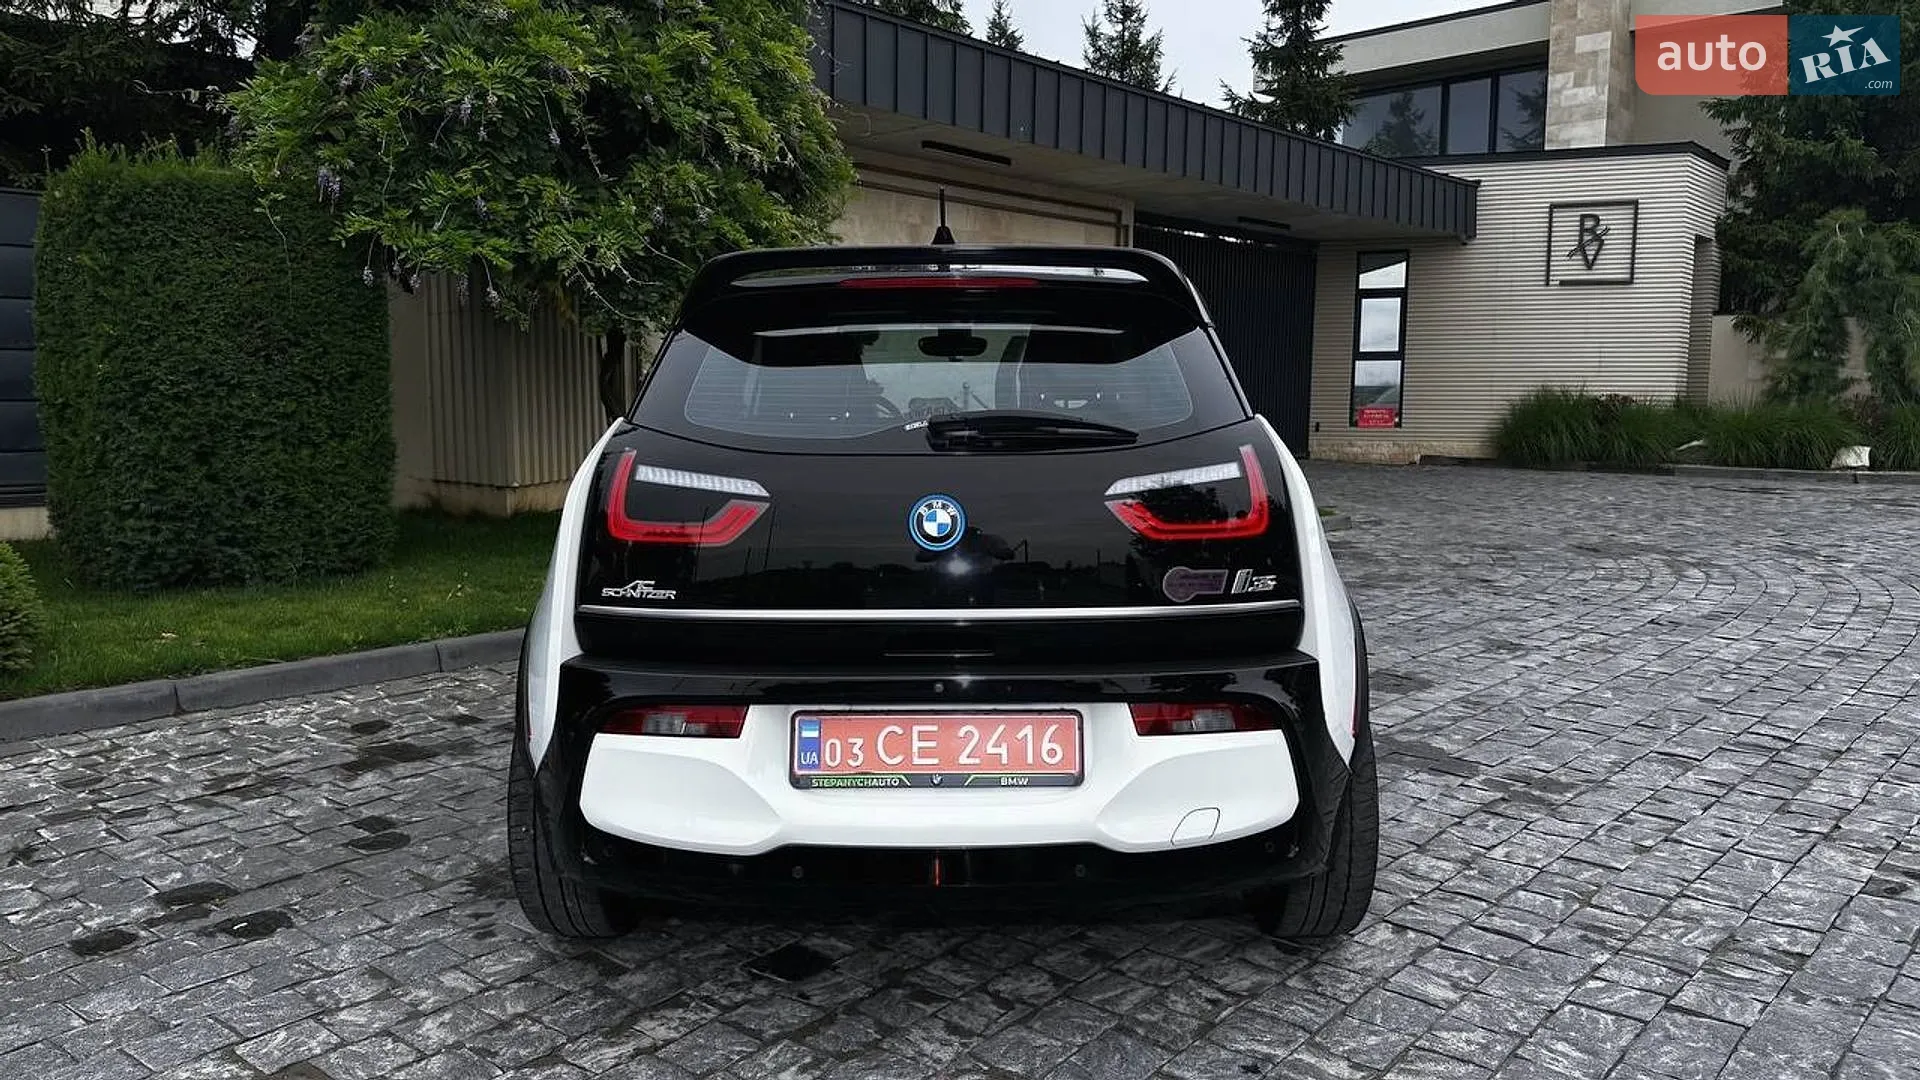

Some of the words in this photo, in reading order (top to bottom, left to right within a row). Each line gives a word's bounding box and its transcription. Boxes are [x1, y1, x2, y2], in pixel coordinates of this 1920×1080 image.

[918, 500, 958, 516] BMW
[800, 752, 819, 765] UA
[824, 738, 865, 768] 03
[876, 725, 940, 767] CE
[957, 724, 1065, 767] 2416
[811, 777, 900, 788] STEPANYCHAUTO
[1000, 777, 1029, 787] BMW
